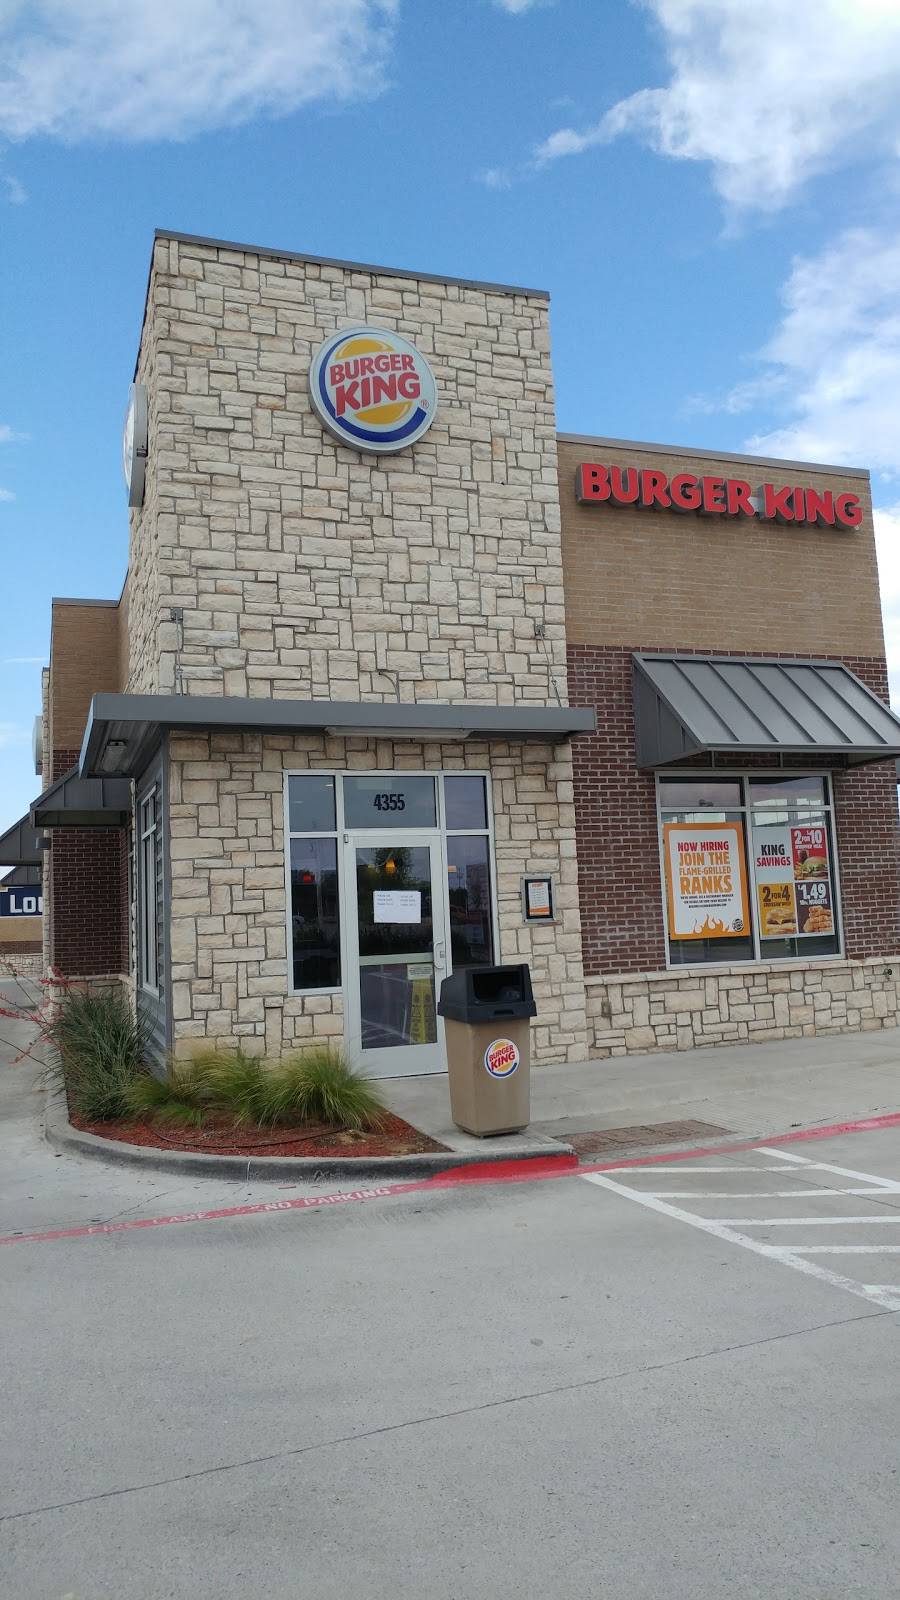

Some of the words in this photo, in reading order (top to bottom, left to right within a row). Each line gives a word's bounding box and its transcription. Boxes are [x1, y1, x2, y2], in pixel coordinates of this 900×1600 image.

[330, 354, 415, 386] BURGER
[335, 372, 420, 416] KING
[579, 463, 754, 516] BURGER
[764, 483, 863, 527] KING
[373, 793, 405, 811] 4355
[677, 842, 698, 852] NOW
[700, 841, 729, 851] HIRING
[760, 844, 785, 856] KING
[680, 853, 704, 866] JOIN
[708, 852, 730, 865] THE
[757, 856, 791, 867] SAVINGS
[680, 866, 731, 876] FLAME-GRILLED
[680, 875, 732, 895] RANKS
[763, 886, 771, 902] 2
[489, 1044, 514, 1062] BURGER
[491, 1051, 516, 1071] KING
[264, 1200, 292, 1211] NO
[303, 1187, 391, 1206] PARKING
